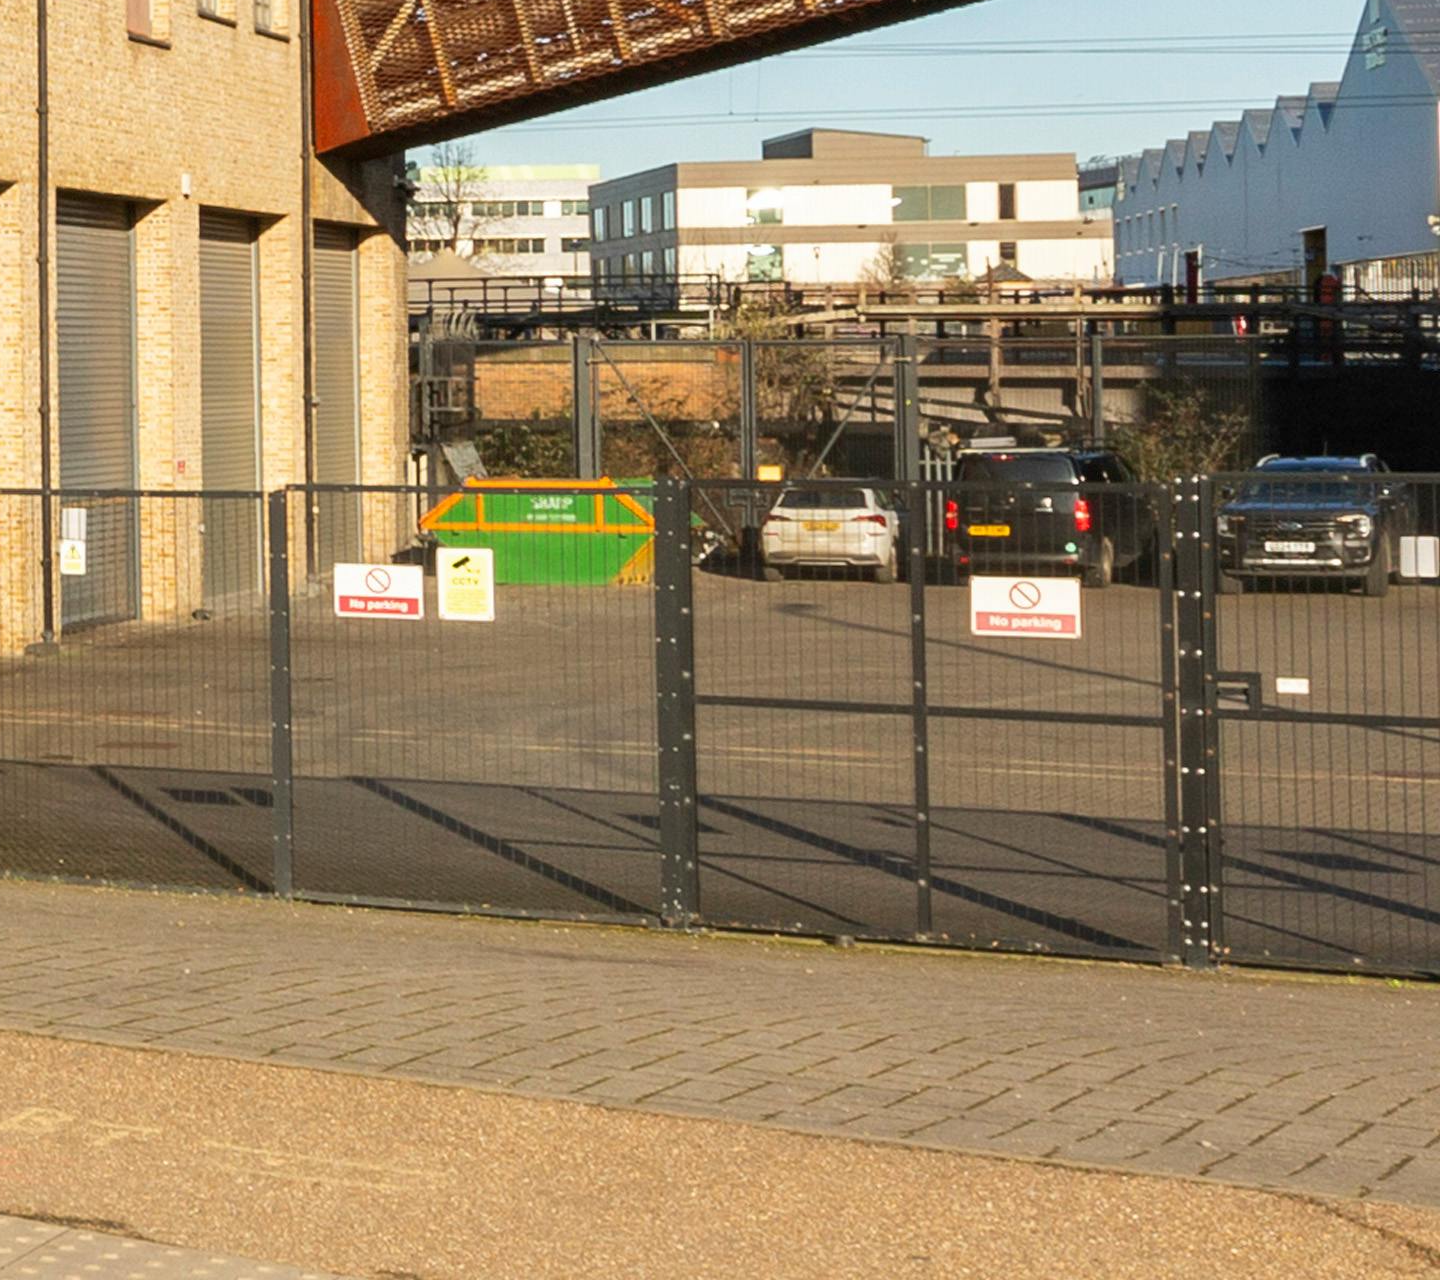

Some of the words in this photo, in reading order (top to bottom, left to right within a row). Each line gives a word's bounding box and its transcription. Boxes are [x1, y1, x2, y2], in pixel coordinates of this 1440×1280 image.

[349, 598, 366, 610] No
[367, 600, 409, 613] parking
[989, 614, 1009, 627] No
[1011, 616, 1062, 632] parking
